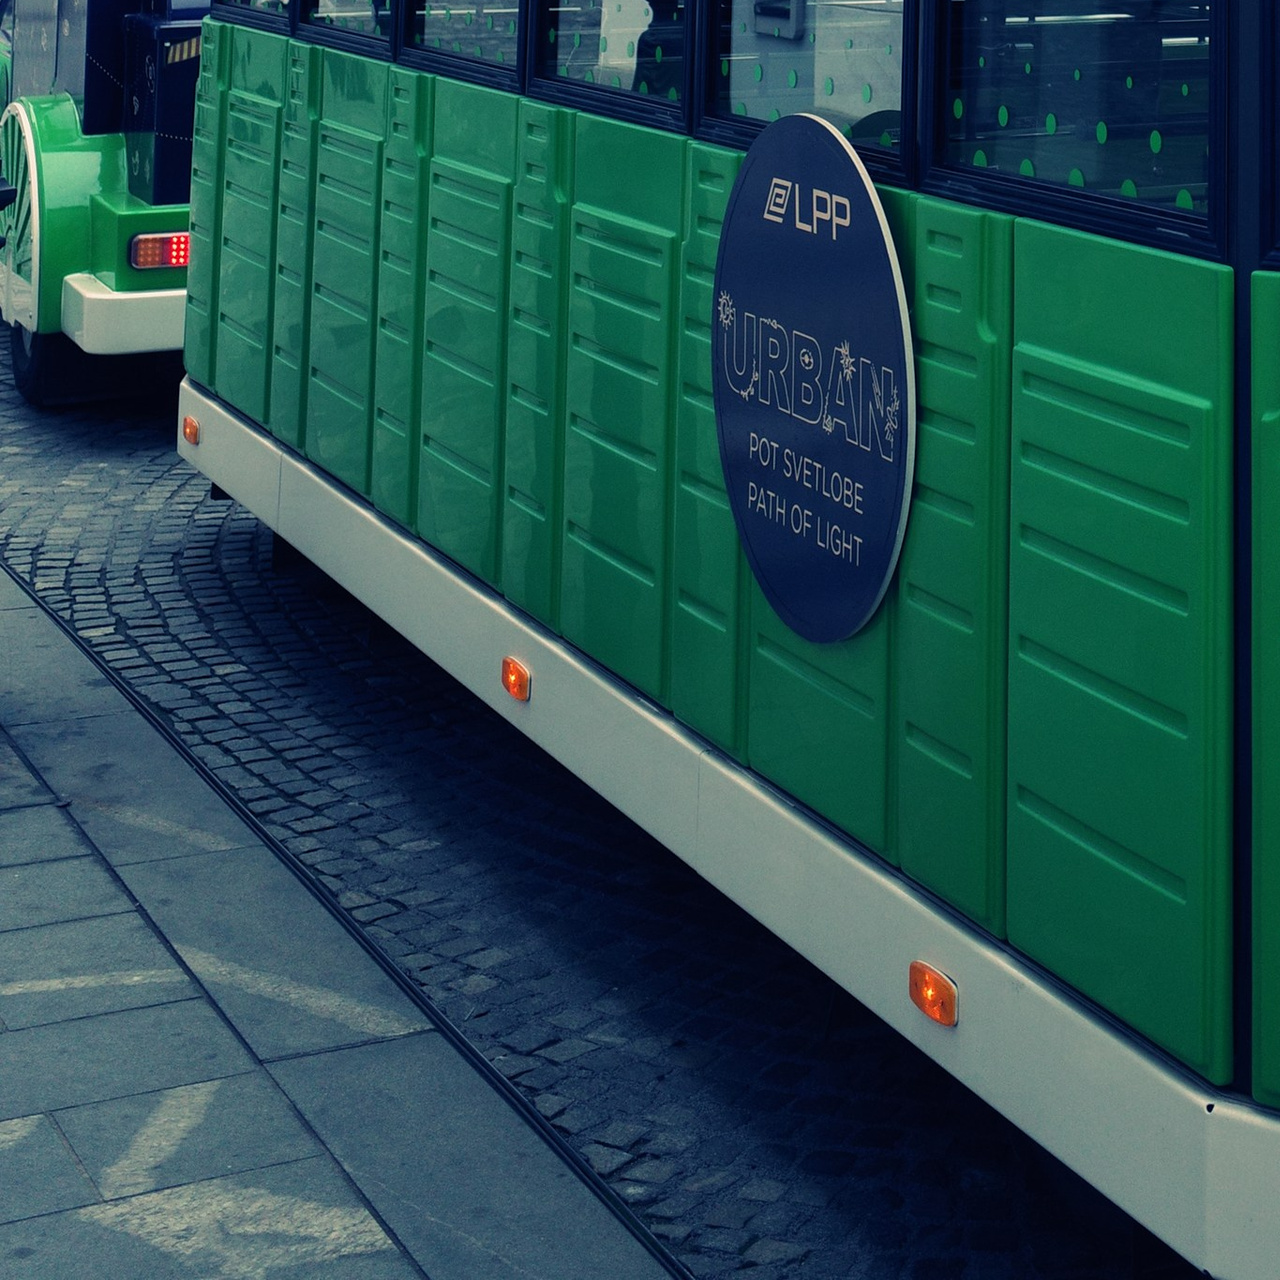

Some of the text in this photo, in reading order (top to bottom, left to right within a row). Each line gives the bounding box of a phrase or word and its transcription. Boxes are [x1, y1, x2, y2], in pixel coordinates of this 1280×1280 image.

[795, 183, 851, 241] LPP
[720, 302, 896, 463] URBAN
[749, 432, 865, 515] POT SVETLOBE
[748, 481, 864, 567] PATH OF LIGHT
